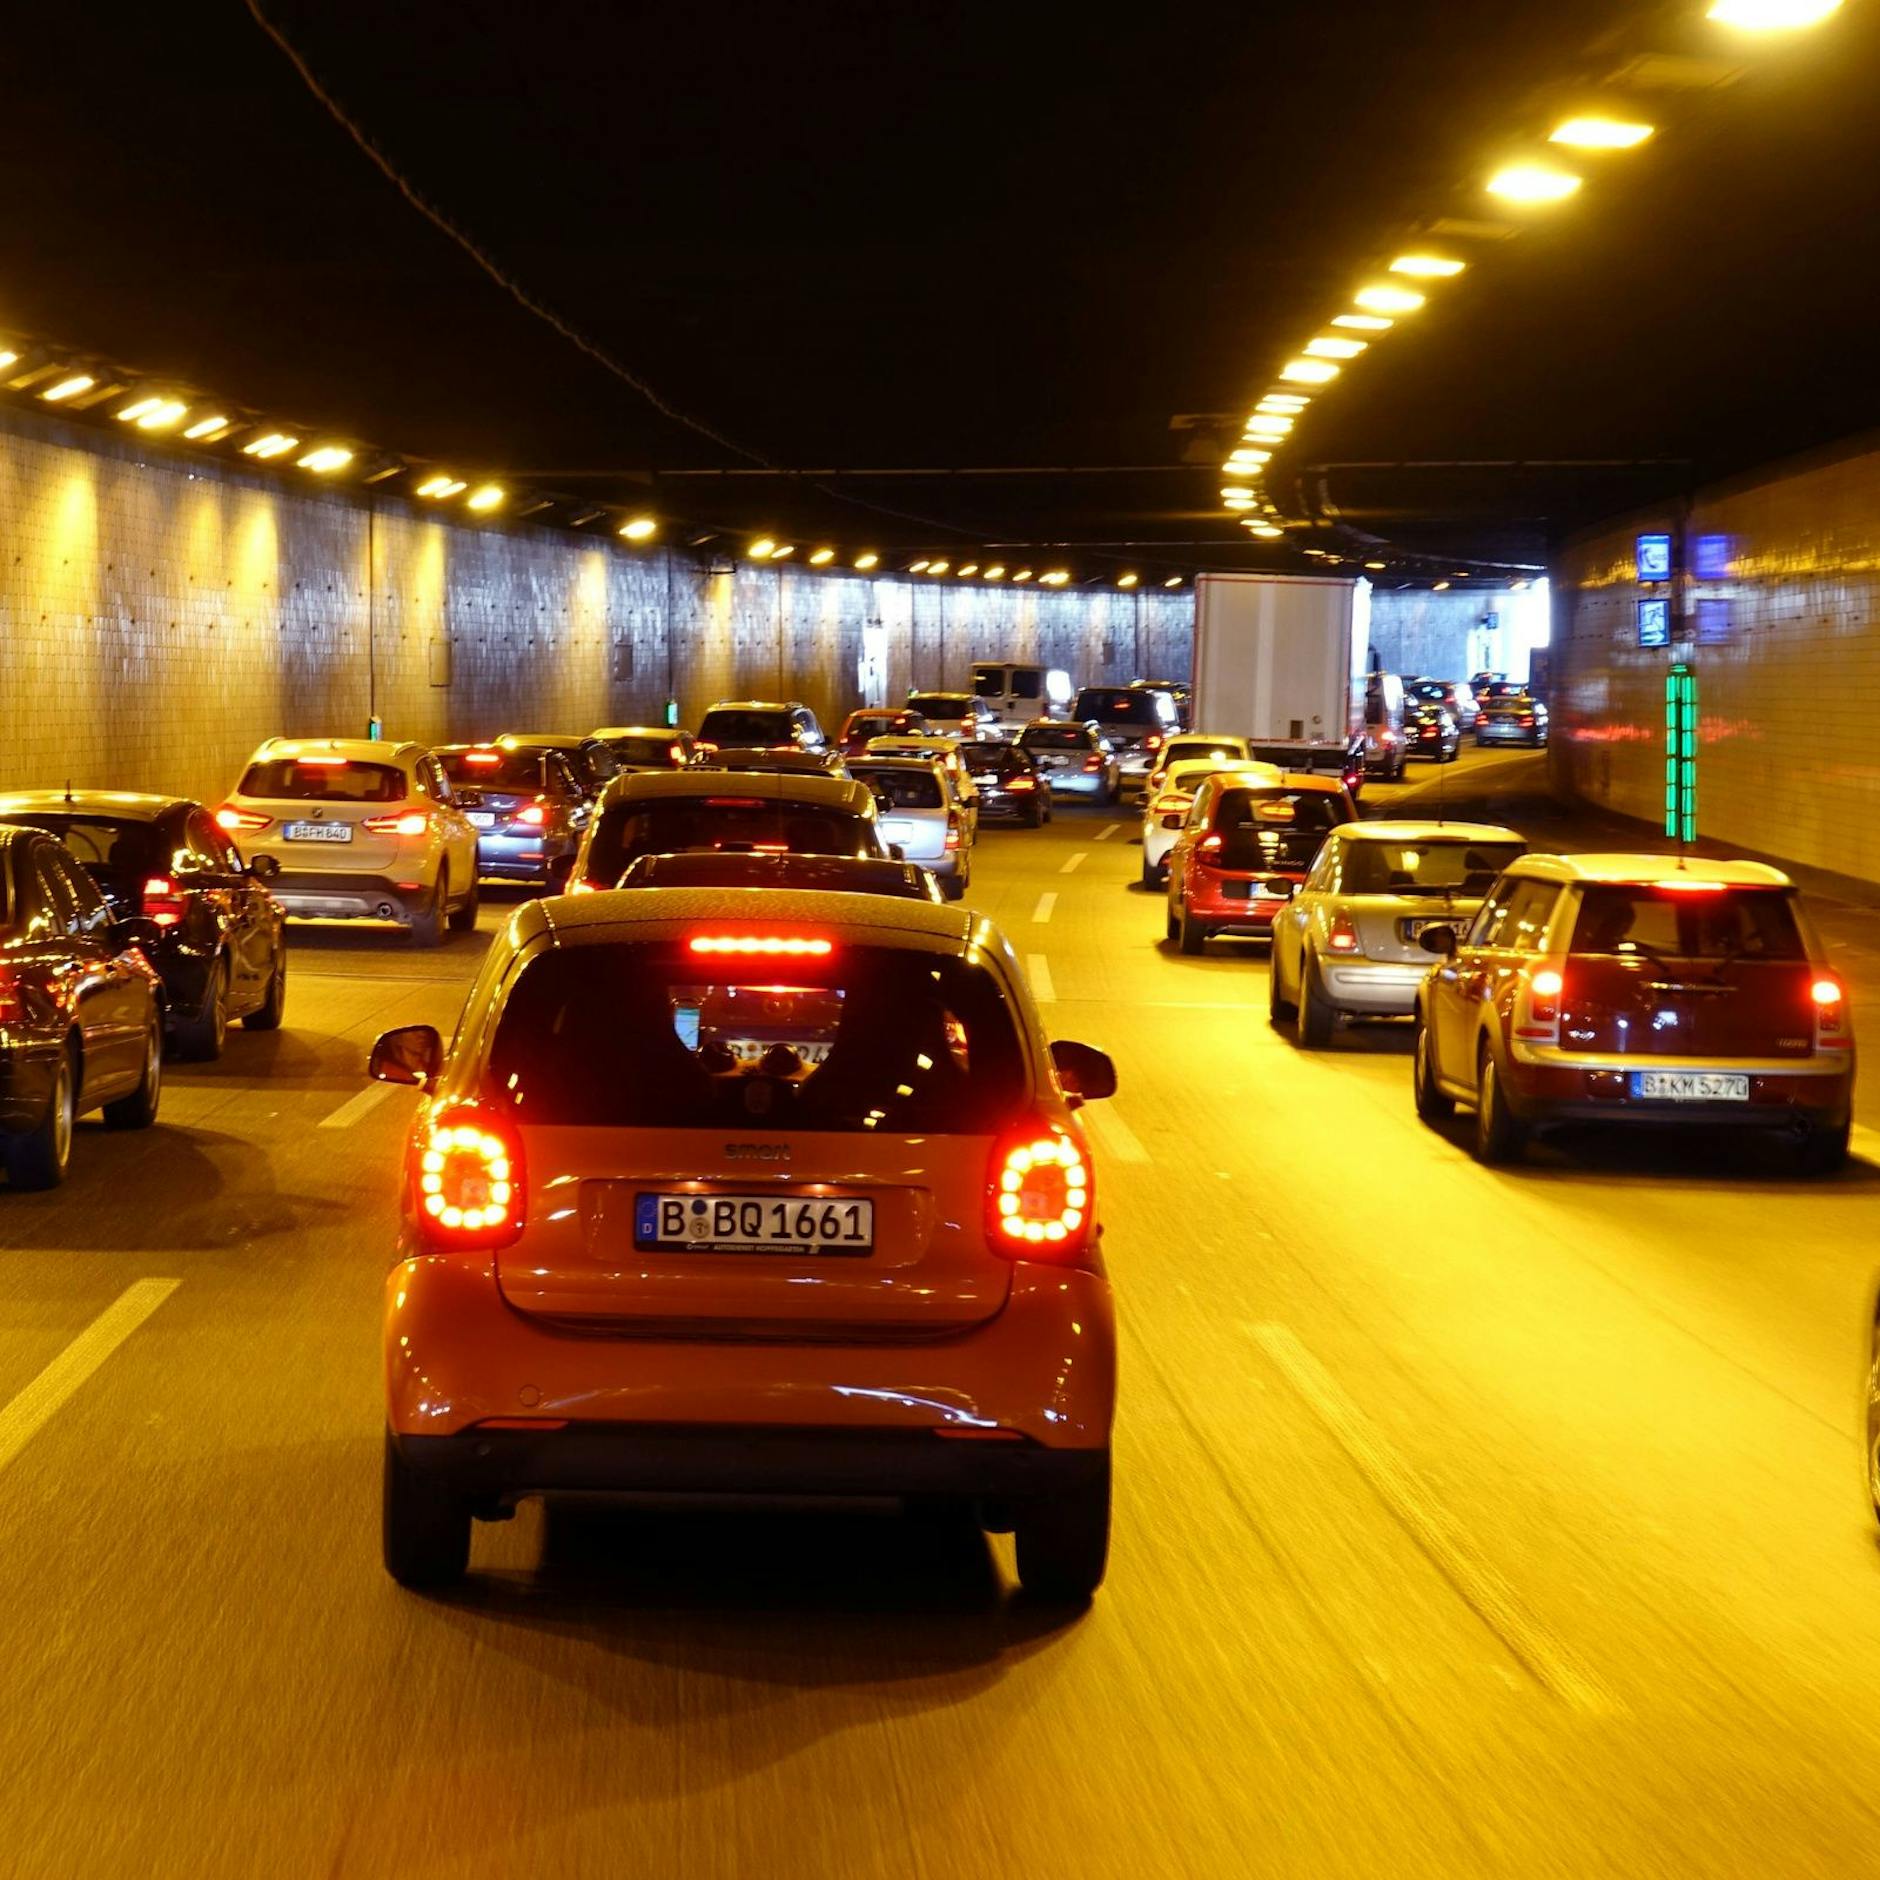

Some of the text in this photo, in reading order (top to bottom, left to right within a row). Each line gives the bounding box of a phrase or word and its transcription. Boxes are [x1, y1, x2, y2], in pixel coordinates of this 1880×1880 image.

[1645, 1075, 1656, 1094] B
[724, 1142, 792, 1161] smart
[662, 1200, 865, 1241] B BQ 1661
